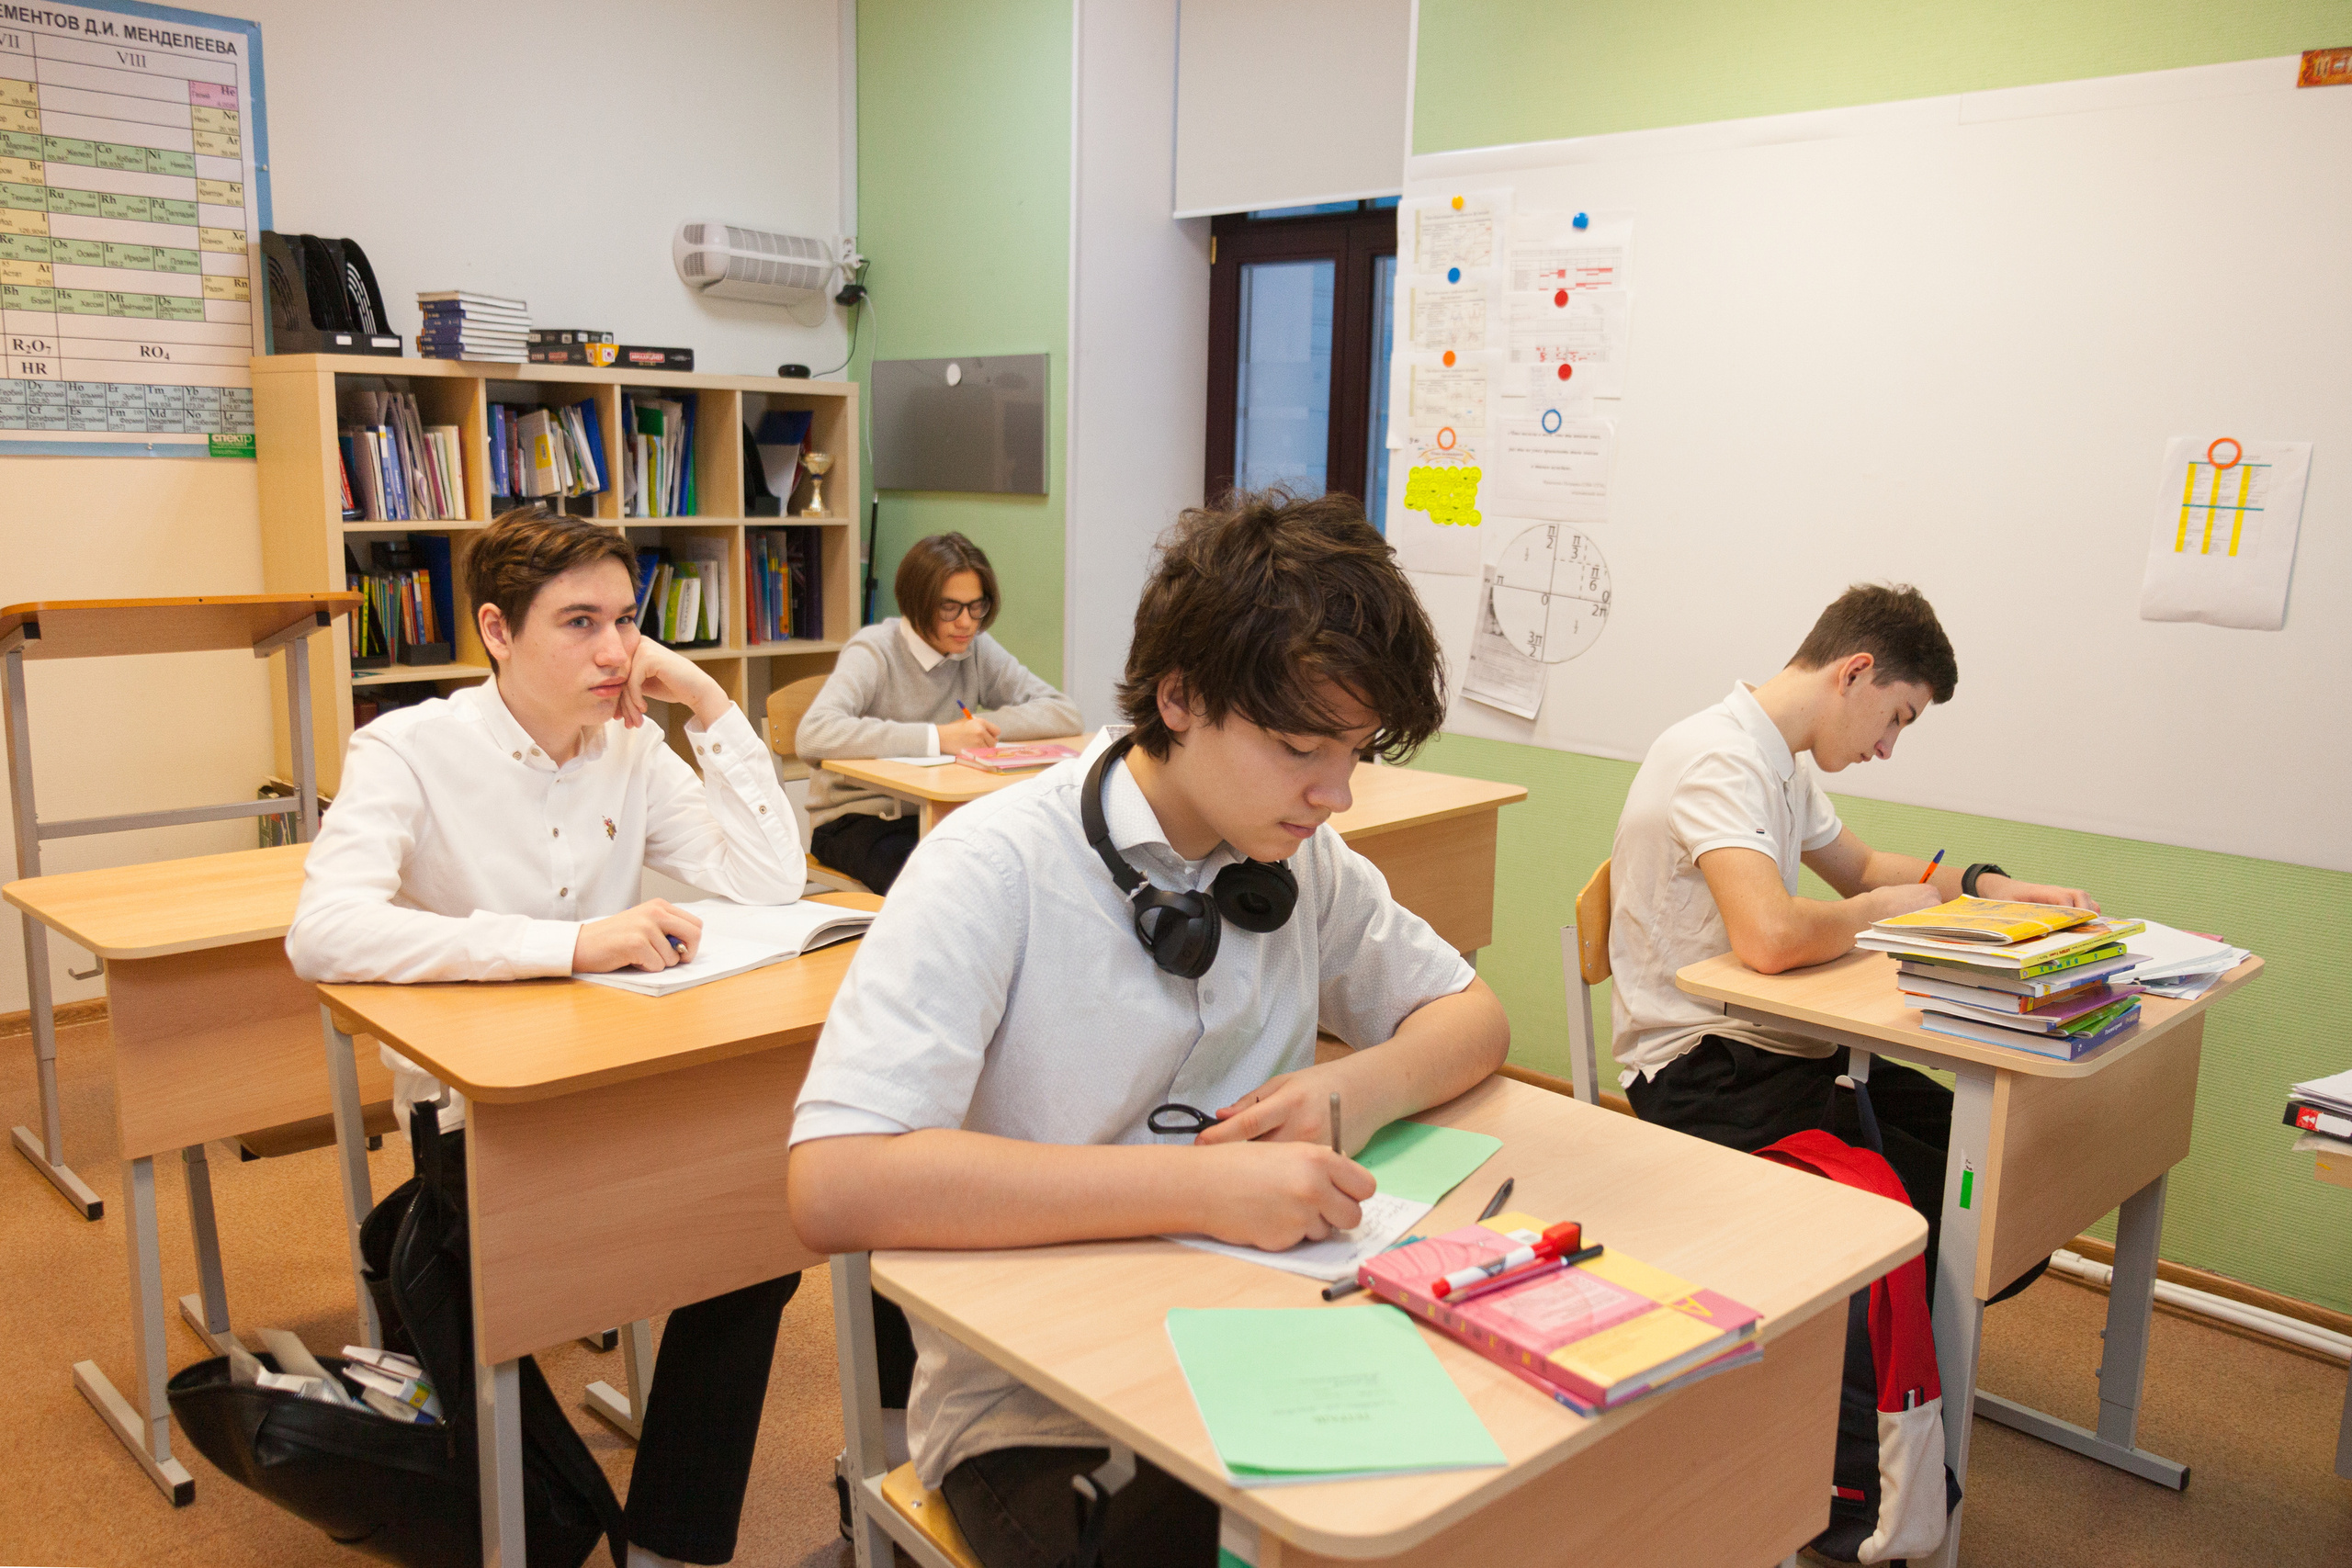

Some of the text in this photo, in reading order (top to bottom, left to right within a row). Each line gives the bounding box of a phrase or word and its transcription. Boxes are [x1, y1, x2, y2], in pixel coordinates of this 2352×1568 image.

[0, 4, 238, 56] МЕНТОВ Д.И. МЕНДЕЛЕЕВА
[117, 51, 147, 68] VIII
[44, 137, 58, 147] Fe
[96, 144, 112, 154] Co
[148, 150, 162, 160] Ni
[29, 161, 42, 171] Br
[49, 188, 65, 199] Ru
[101, 194, 117, 204] Rh
[52, 240, 68, 249] Os
[38, 264, 51, 274] At
[233, 278, 249, 288] Rn
[4, 286, 19, 296] Bh
[57, 289, 73, 299] Hs
[140, 345, 171, 361] RO4
[22, 361, 49, 376] HR
[69, 381, 85, 392] Ho
[187, 387, 199, 397] Yb
[149, 409, 167, 419] Md
[187, 410, 201, 420] No
[1546, 537, 1554, 549] 2
[1571, 547, 1578, 559] 3
[1589, 580, 1597, 592] 6
[1529, 646, 1536, 658] 2
